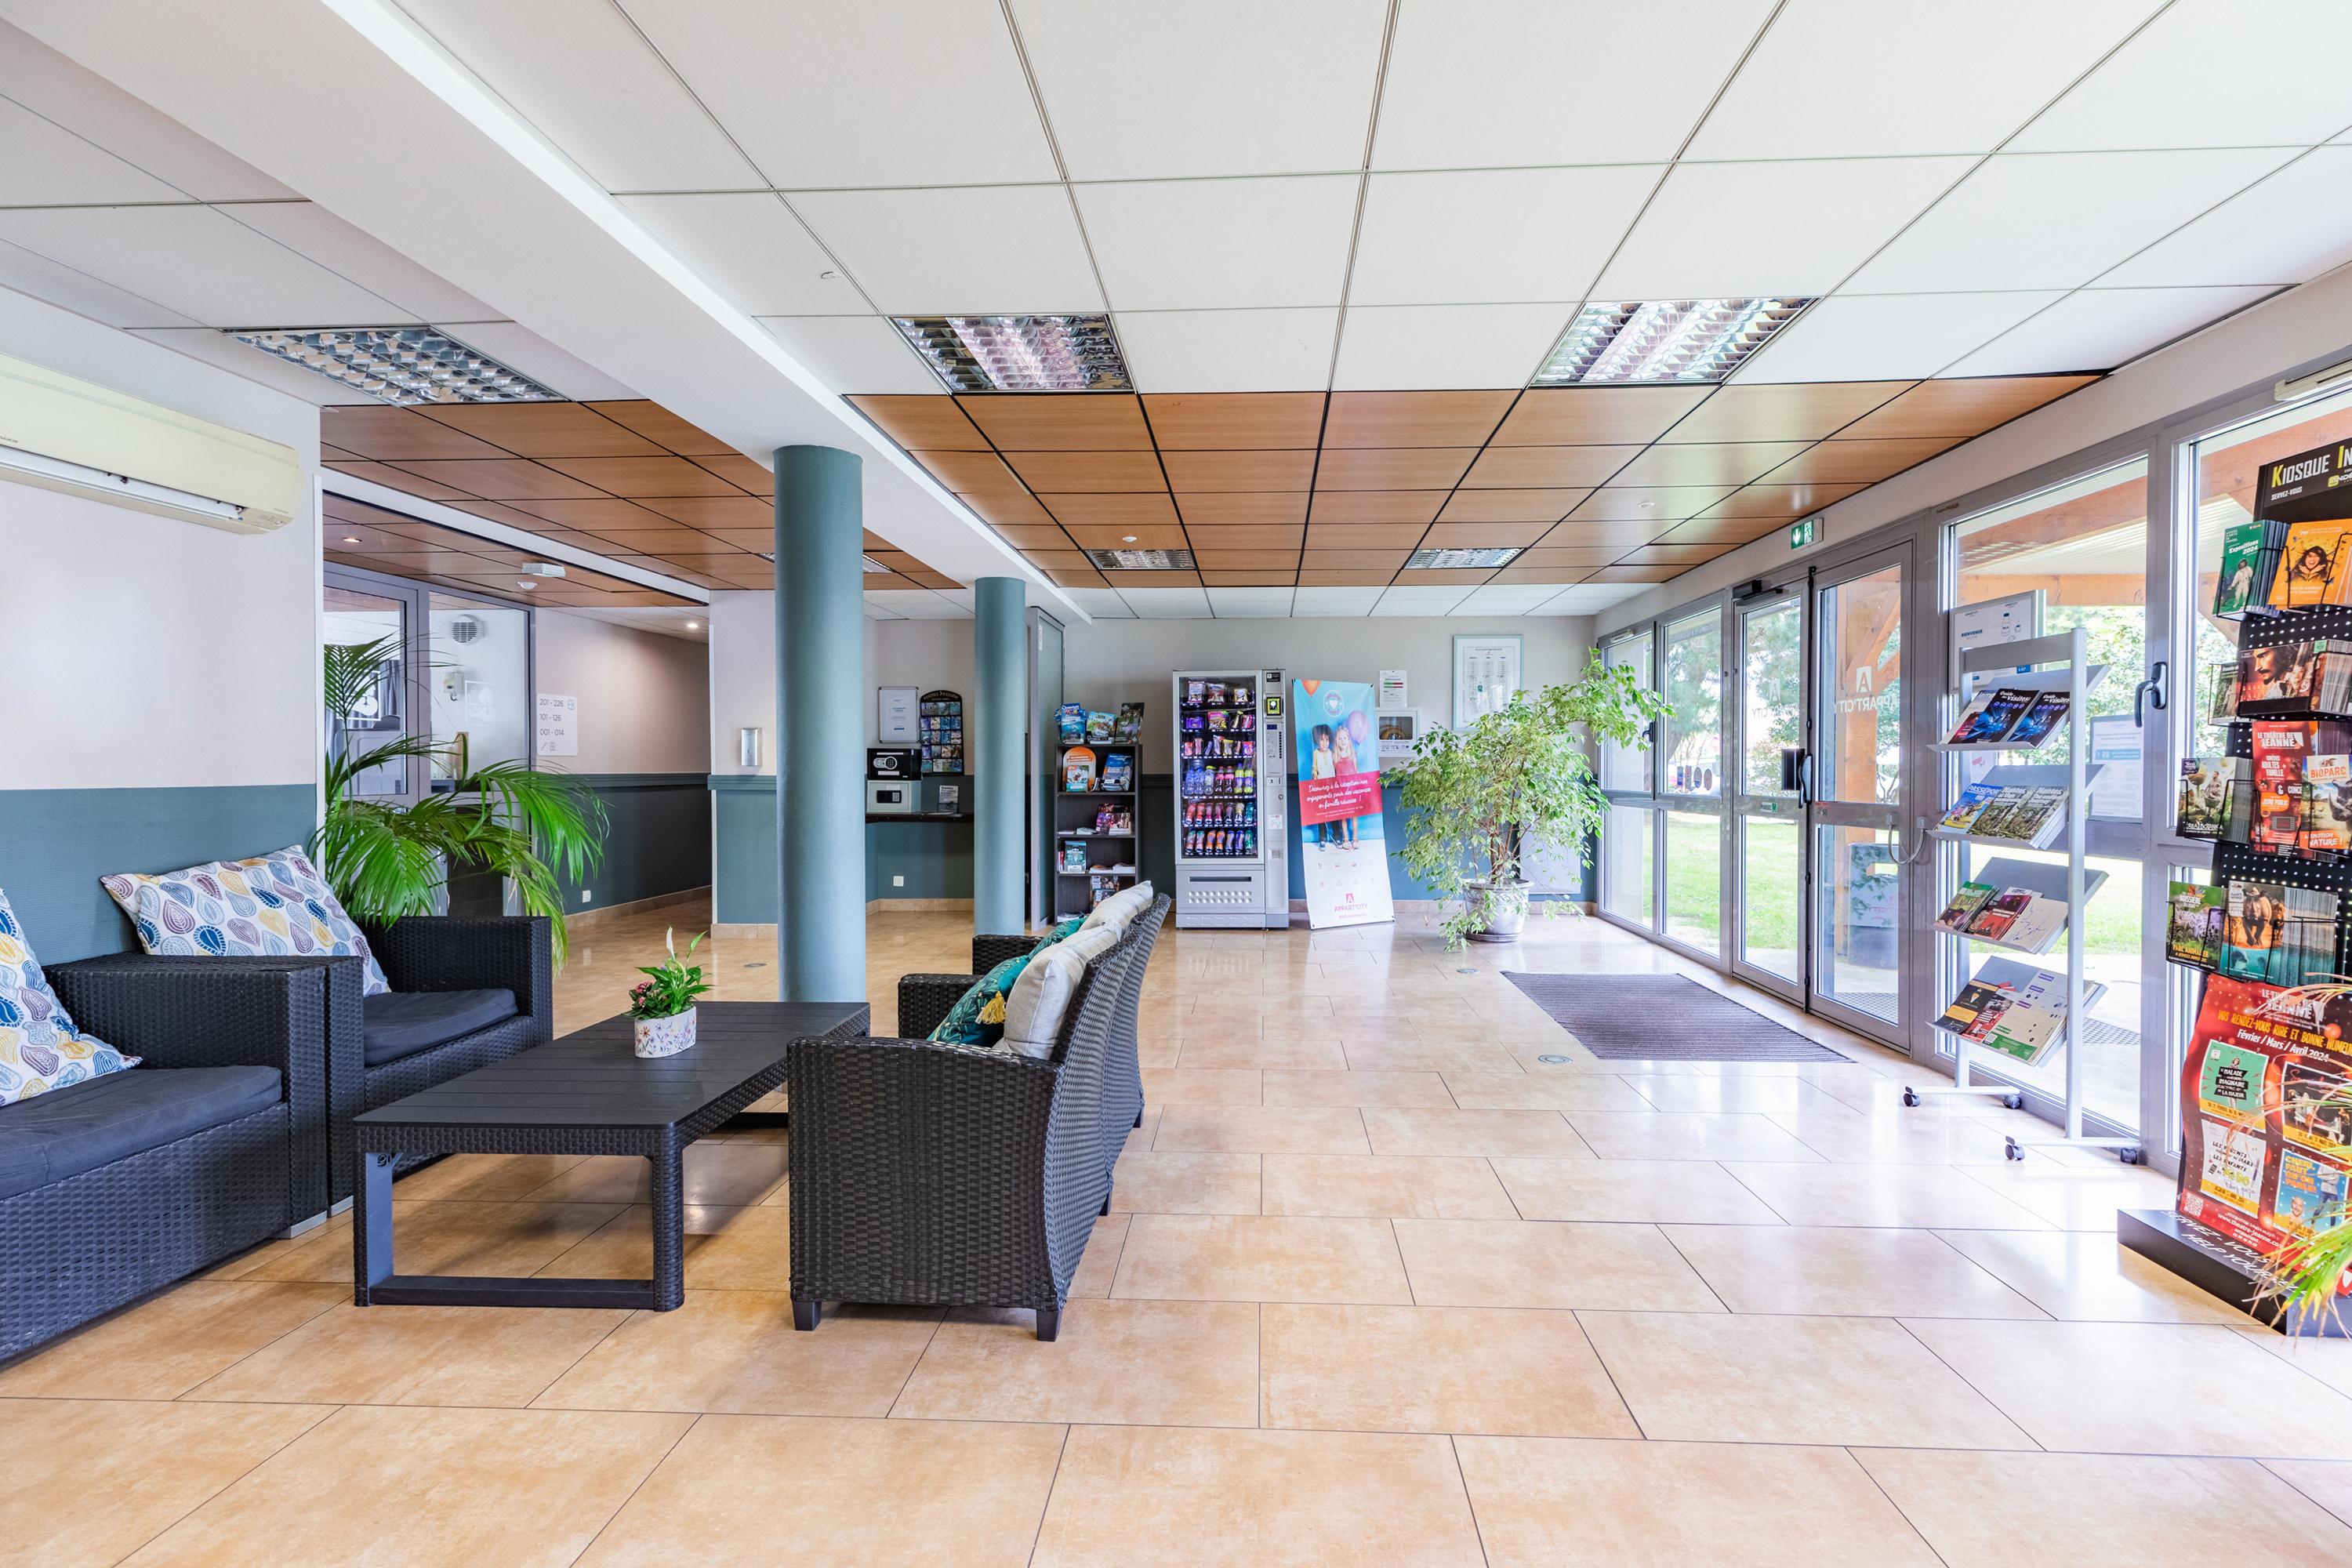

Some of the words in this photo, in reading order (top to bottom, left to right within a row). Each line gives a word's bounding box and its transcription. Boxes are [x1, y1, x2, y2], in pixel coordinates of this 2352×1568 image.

[2271, 454, 2331, 488] KIOSQUE
[2271, 486, 2303, 501] SERVEZ-VOUS
[2229, 539, 2259, 554] Expositions
[2242, 545, 2259, 555] 2024
[539, 698, 549, 706] 201
[2261, 738, 2296, 748] JEANNE
[2231, 1013, 2271, 1033] RENDEZ-VOUS
[2273, 1024, 2288, 1037] RIRE
[2290, 1029, 2300, 1040] ET
[2237, 1029, 2261, 1044] Février
[2266, 1037, 2284, 1050] Mars
[2289, 1044, 2308, 1055] Avril
[2182, 1233, 2227, 1254] HELP
